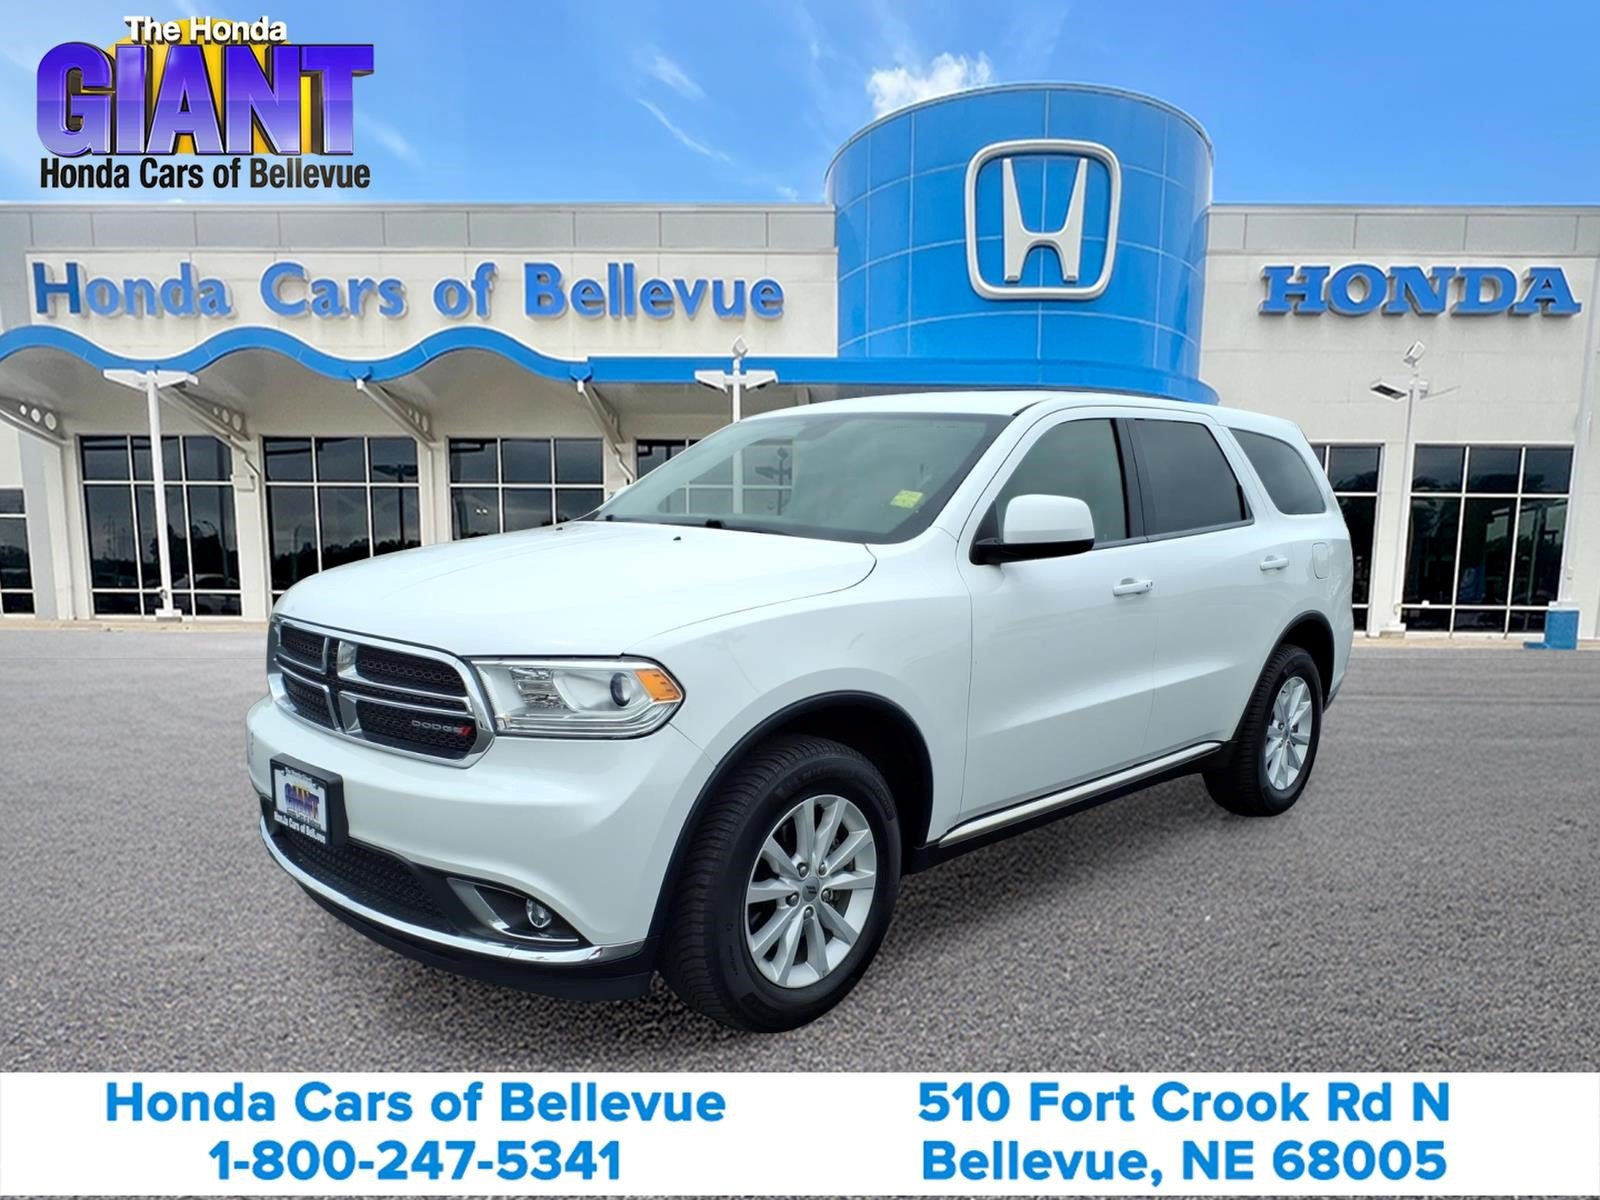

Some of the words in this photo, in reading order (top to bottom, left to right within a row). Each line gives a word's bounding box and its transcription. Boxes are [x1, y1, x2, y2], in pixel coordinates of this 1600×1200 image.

[32, 262, 231, 316] Honda
[260, 261, 406, 317] Cars
[433, 262, 496, 317] of
[523, 262, 784, 318] Bellevue
[1260, 264, 1582, 317] HONDA
[411, 720, 463, 733] DODGE
